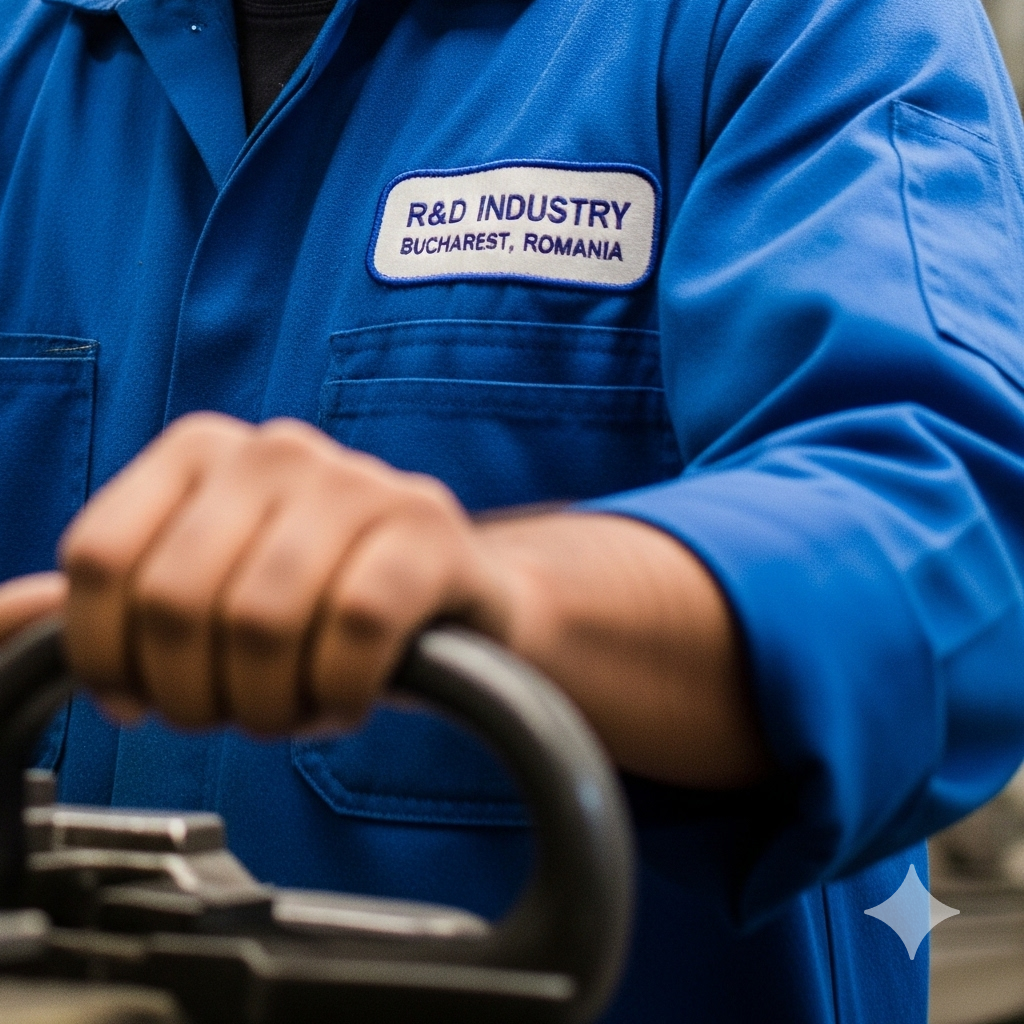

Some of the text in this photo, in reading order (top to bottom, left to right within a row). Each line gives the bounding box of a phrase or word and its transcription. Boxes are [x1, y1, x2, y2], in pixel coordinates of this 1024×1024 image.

[406, 194, 631, 230] R&D INDUSTRY
[400, 232, 624, 261] BUCHAREST, ROMANIA
